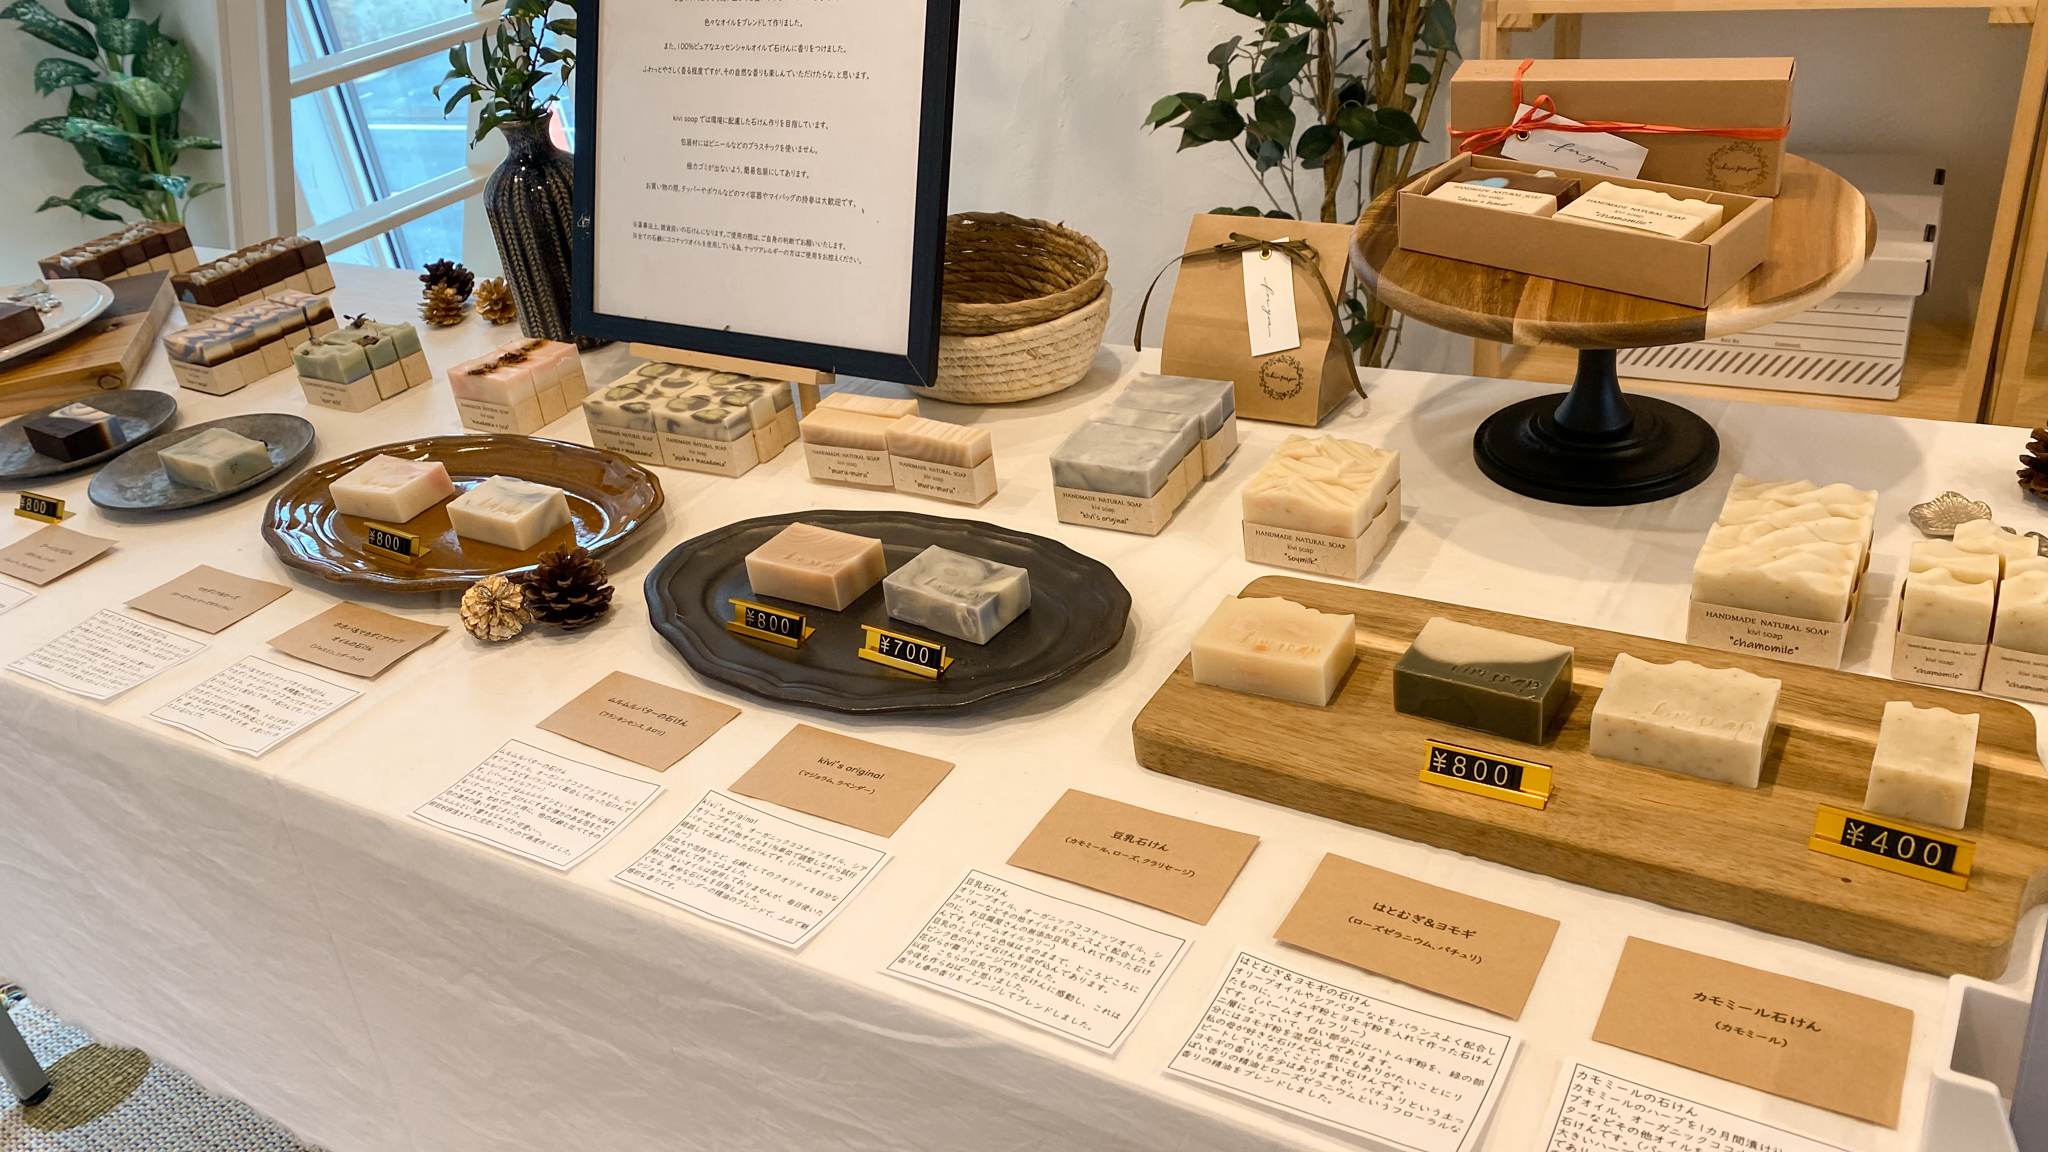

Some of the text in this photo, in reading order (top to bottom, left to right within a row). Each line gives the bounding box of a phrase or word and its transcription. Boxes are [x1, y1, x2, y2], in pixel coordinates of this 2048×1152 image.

[704, 18, 804, 28] 色々なオイルをブレンドして作りました。
[672, 114, 683, 123] kivi
[699, 116, 829, 130] では環境に配慮した石けん作りを目指しています。
[680, 138, 818, 155] 包装材にはビニールなどのプラスチックを使いません。
[686, 162, 810, 179] 極力ゴミが出ないよう、簡易包装にしてあります。
[1586, 197, 1687, 222] HANDMADE NATURAL SOAP
[812, 449, 841, 458] HANDMADE
[842, 453, 865, 461] NATURAL
[899, 461, 967, 479] HANDMADE NATURAL SOAP
[1062, 492, 1096, 502] HANDMADE
[1098, 497, 1126, 506] NATURAL
[1101, 506, 1116, 514] soap
[368, 529, 401, 552] ¥800
[1255, 529, 1347, 550] HANDMADE NATURAL SOAP
[1287, 543, 1314, 555] kivi soap
[1284, 552, 1318, 565] "soymilk"
[745, 608, 791, 635] ¥800
[1705, 610, 1830, 636] HANDMADE NATURAL SOAP
[1747, 627, 1784, 641] kivi soap
[880, 635, 930, 665] ¥700
[1729, 635, 1799, 655] "chamomile"
[607, 696, 689, 728] ムルムルバターの石けん
[798, 768, 876, 796] （マジョラム、ラベンダー）
[817, 756, 886, 781] kivi's original
[1432, 749, 1510, 787] ¥800
[724, 808, 760, 825] original
[1109, 830, 1170, 853] 豆乳石けん
[1845, 821, 1943, 868] ¥400
[1064, 836, 1196, 878] （カモミール、ローズ、クラリセージ）
[963, 877, 1011, 898] 豆乳石けん
[950, 892, 1158, 968] アバターなどその他オイルをバランスよく配合したも
[957, 885, 1164, 959] オリーブオイル、オーガニックココナッツオイル、シ
[1372, 901, 1478, 940] はとむぎ&ヨモギ
[944, 900, 1152, 976] のに、お豆腐屋さんの無添加豆乳を入れて作った石け
[1347, 915, 1483, 965] （ローズゼラニウム、パチュリ）
[917, 931, 1060, 984] 花びらが舞うイメージで作りました。
[910, 939, 1122, 1019] 以前、こちらの豆乳で作った石けんに感動し、これは
[1238, 956, 1373, 1008] はとむぎ&ヨモギの石けん
[1227, 975, 1493, 1067] たものに、ハトムギ粉とヨモギ粉を入れて作った石けん
[1232, 966, 1498, 1056] オリーブオイルやシアバターなどをバランスよく配合し
[1691, 990, 1823, 1034] カモミール石けん
[1209, 1004, 1395, 1069] 分にはヨモギ粉を混ぜ込んであります。
[1714, 1019, 1789, 1049] （カモミール）
[1198, 1022, 1407, 1094] ピートしていただくことが多い石けんです。
[1204, 1013, 1464, 1102] 私の母が好きな石けんで、他にもありがたいことにリ
[1179, 1048, 1336, 1105] 香りの精油をブレンドしました。
[1576, 1070, 1699, 1117] カモミールの石けん
[1570, 1094, 1745, 1152] ブオイル、オーガニックココ
